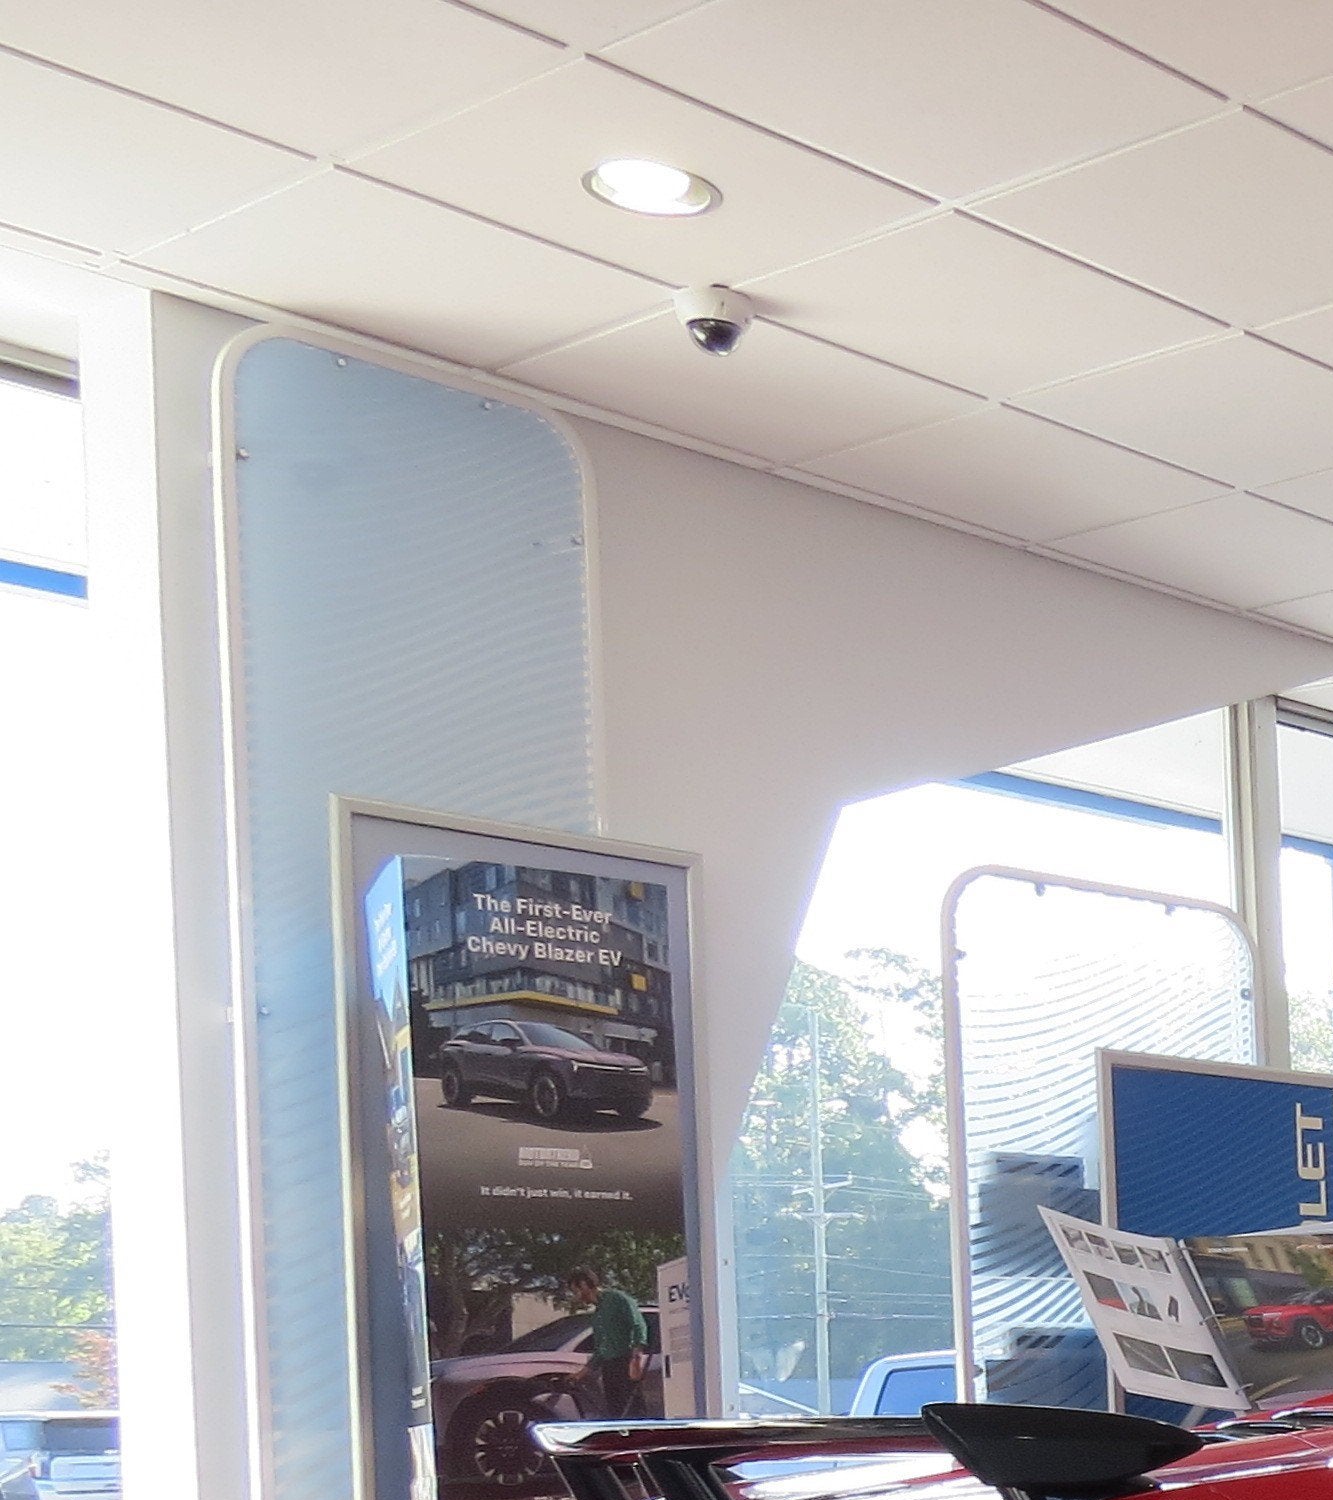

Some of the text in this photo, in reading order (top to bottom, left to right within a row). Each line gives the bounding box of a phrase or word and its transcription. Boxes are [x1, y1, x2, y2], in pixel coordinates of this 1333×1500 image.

[473, 893, 612, 925] The First-Ever
[489, 917, 601, 944] All-Electric
[467, 936, 622, 967] Chevy Blazer EV
[1296, 1102, 1327, 1222] LET
